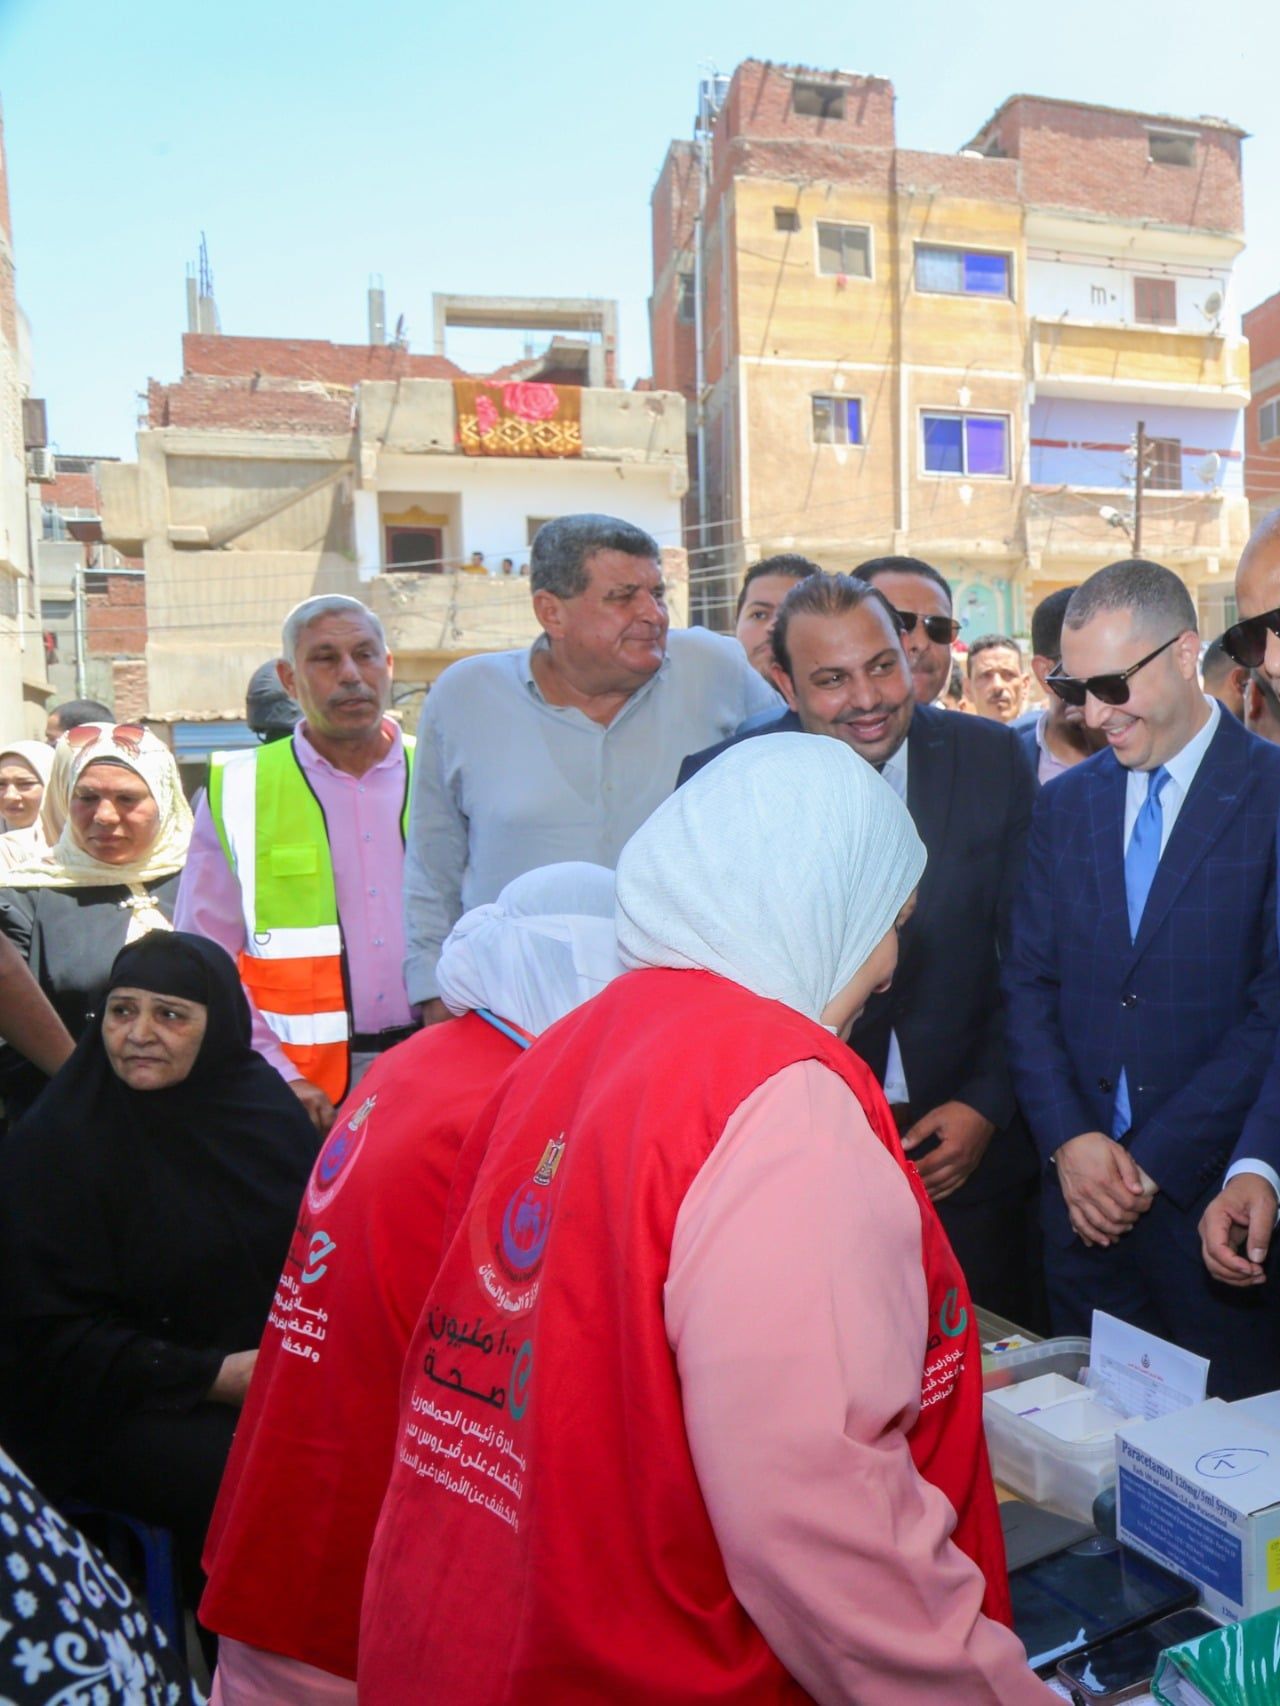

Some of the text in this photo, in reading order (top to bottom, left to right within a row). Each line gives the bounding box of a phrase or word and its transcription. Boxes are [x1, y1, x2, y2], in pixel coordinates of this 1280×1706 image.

[288, 1318, 326, 1341] للقض
[428, 1304, 494, 1354] مليون
[281, 1336, 320, 1363] والكش
[424, 1346, 505, 1411] صحة
[924, 1359, 948, 1377] رئيس
[461, 1417, 496, 1447] رئيس
[416, 1461, 435, 1477] غير
[460, 1451, 488, 1473] على
[1121, 1439, 1173, 1483] Paracetamol
[1175, 1475, 1214, 1508] 120mg/5ml
[1215, 1499, 1237, 1523] Syrup
[467, 1485, 488, 1505] عن
[485, 1494, 519, 1533] والكشف
